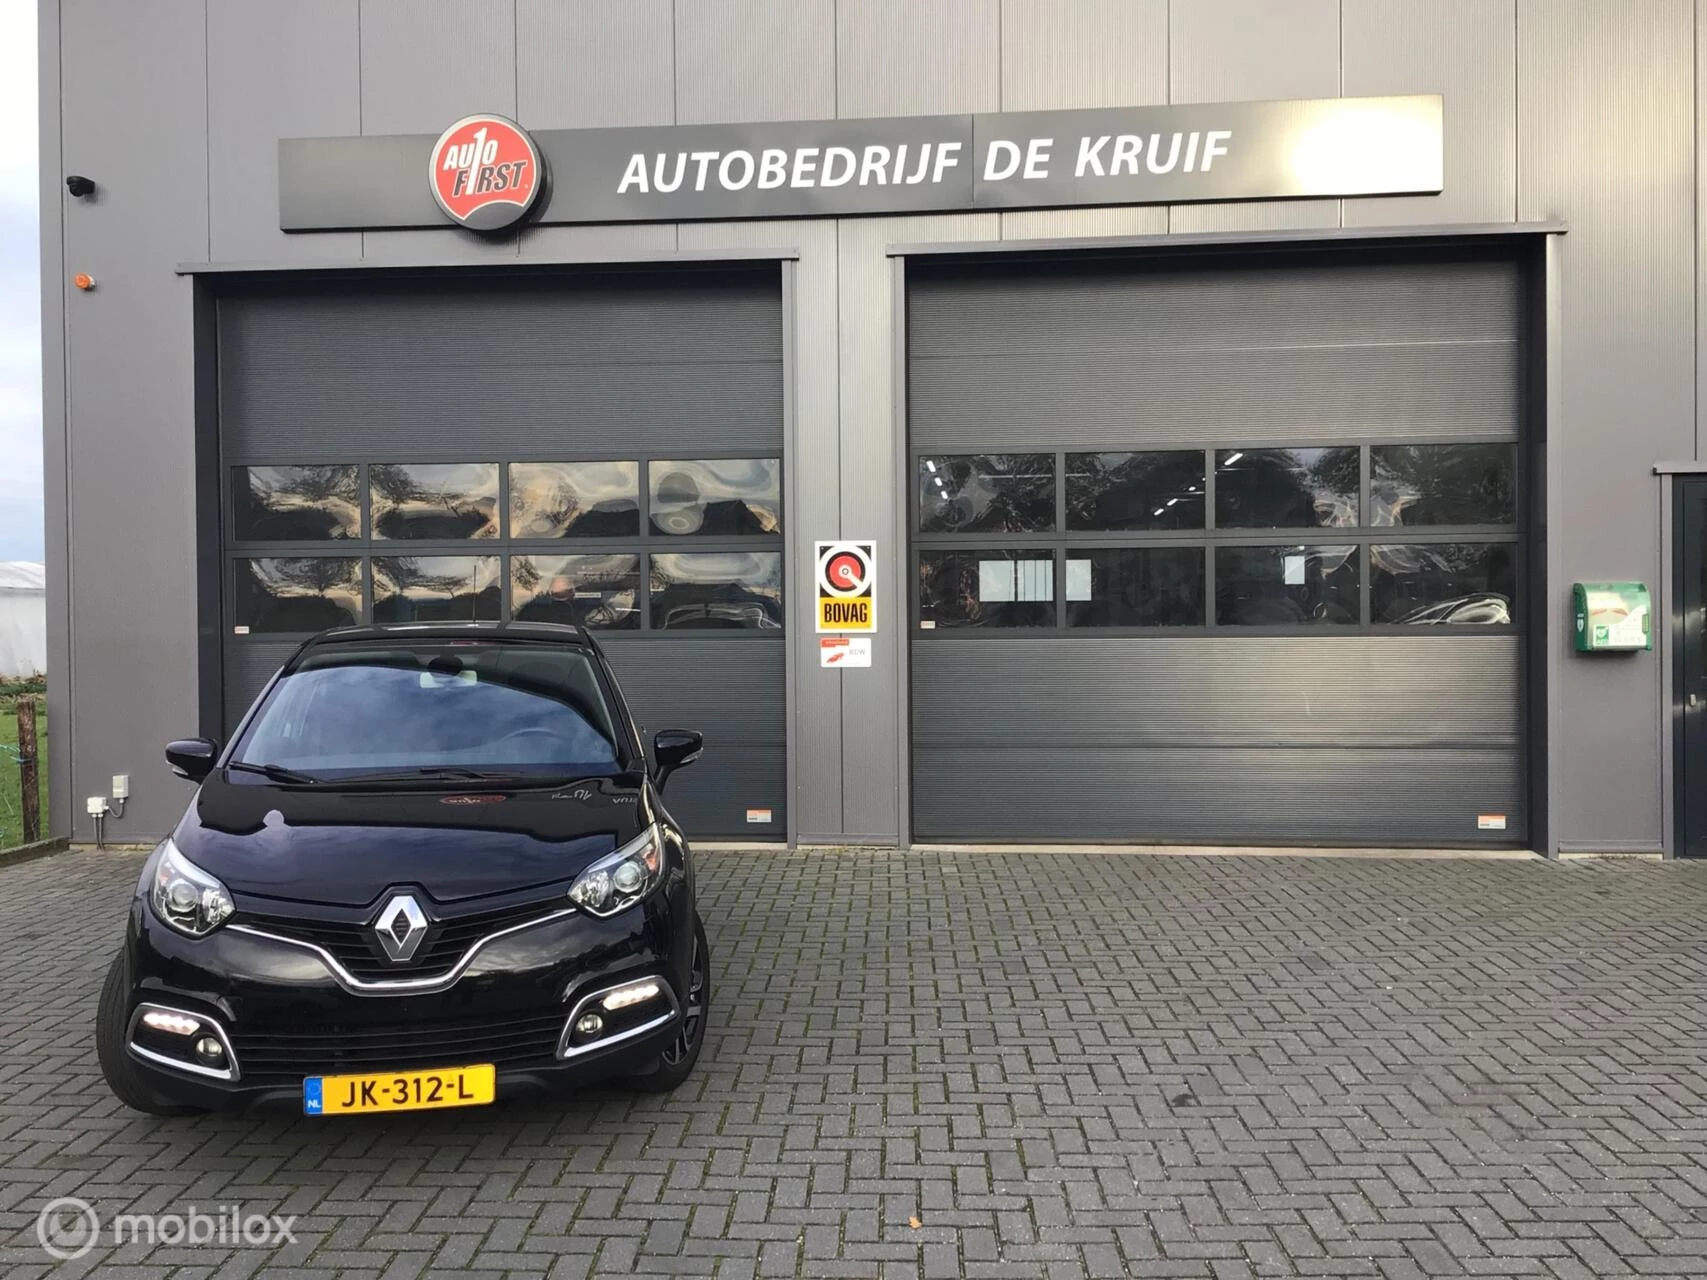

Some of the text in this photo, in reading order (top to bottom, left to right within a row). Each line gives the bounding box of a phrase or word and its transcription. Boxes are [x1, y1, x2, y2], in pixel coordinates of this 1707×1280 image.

[443, 128, 499, 170] AUTO
[617, 130, 1232, 193] AUTOBEDRIJF DE KRUIF
[452, 160, 528, 197] FIRST
[824, 603, 867, 623] BOVAG
[307, 1099, 321, 1108] NL
[342, 1074, 474, 1107] JK-312-L
